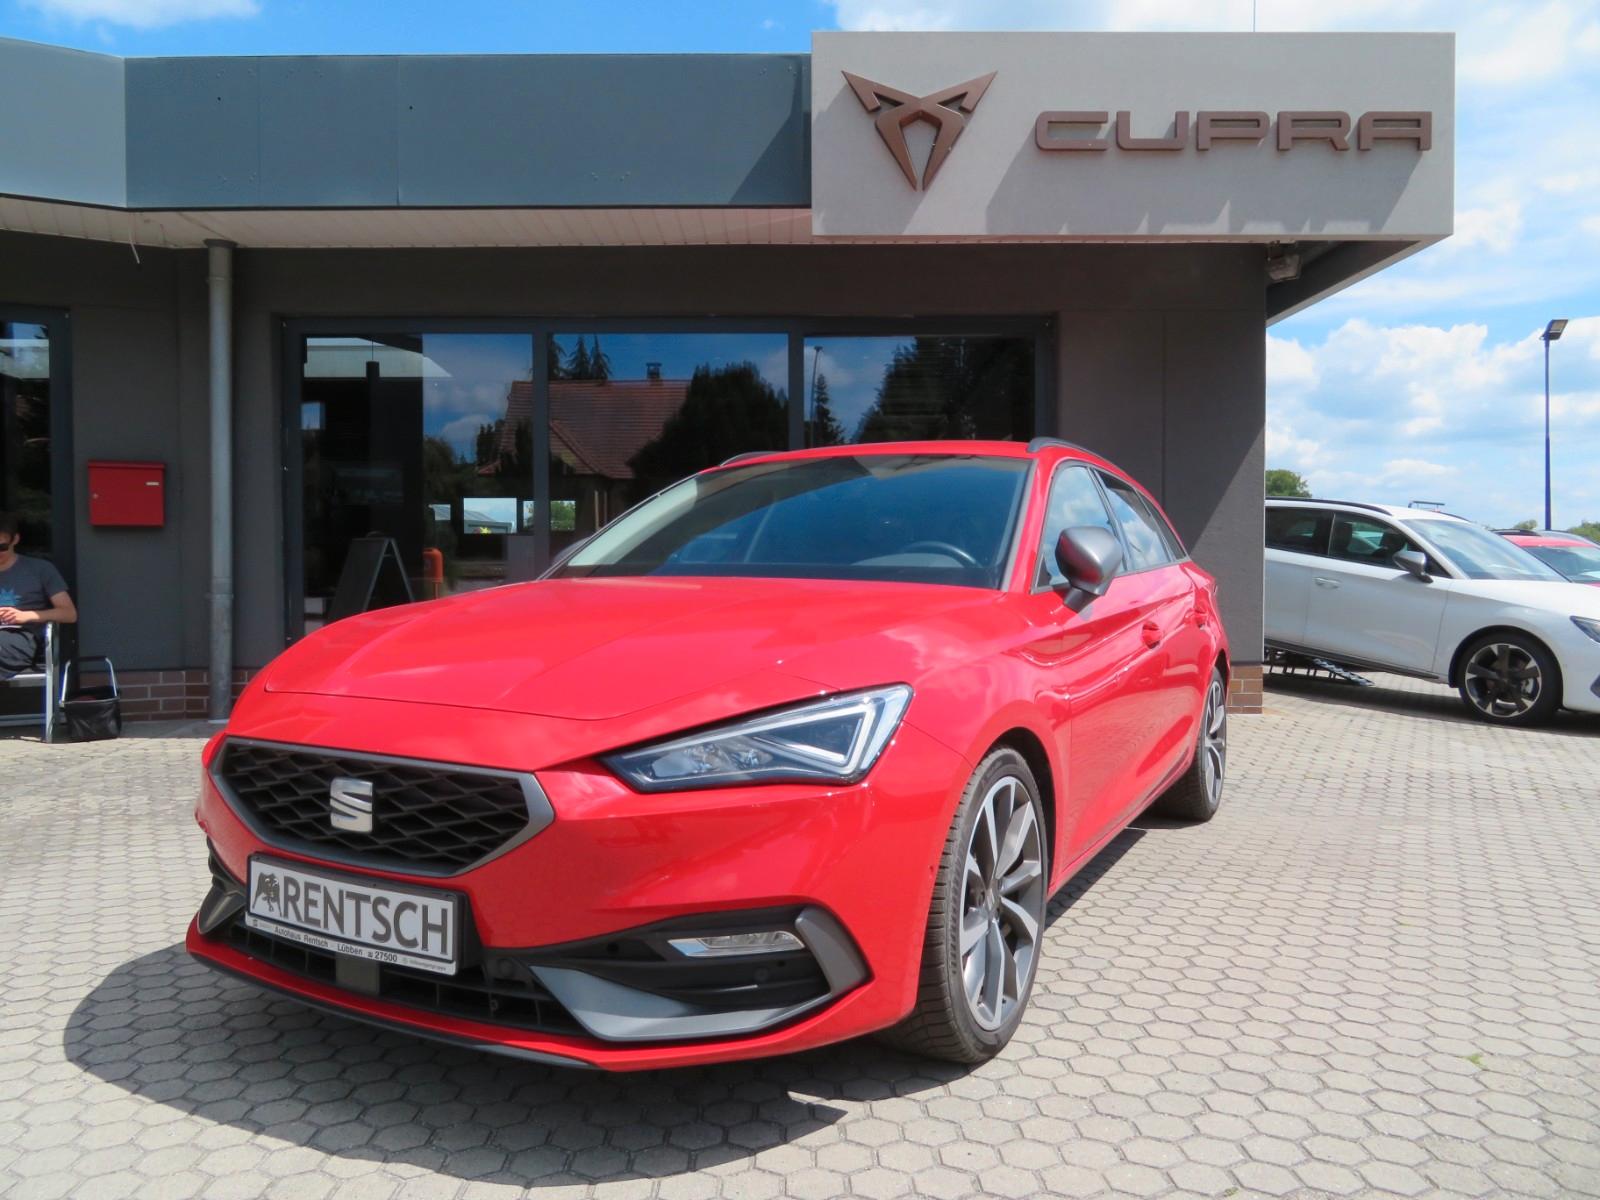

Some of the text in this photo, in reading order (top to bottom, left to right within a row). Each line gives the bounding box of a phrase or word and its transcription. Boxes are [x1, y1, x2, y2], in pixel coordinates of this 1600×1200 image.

[1035, 110, 1432, 152] CUPRA
[282, 876, 448, 956] RENTSCH
[303, 934, 329, 948] Rentsch
[337, 943, 363, 956] Lübben
[374, 951, 398, 963] 27500
